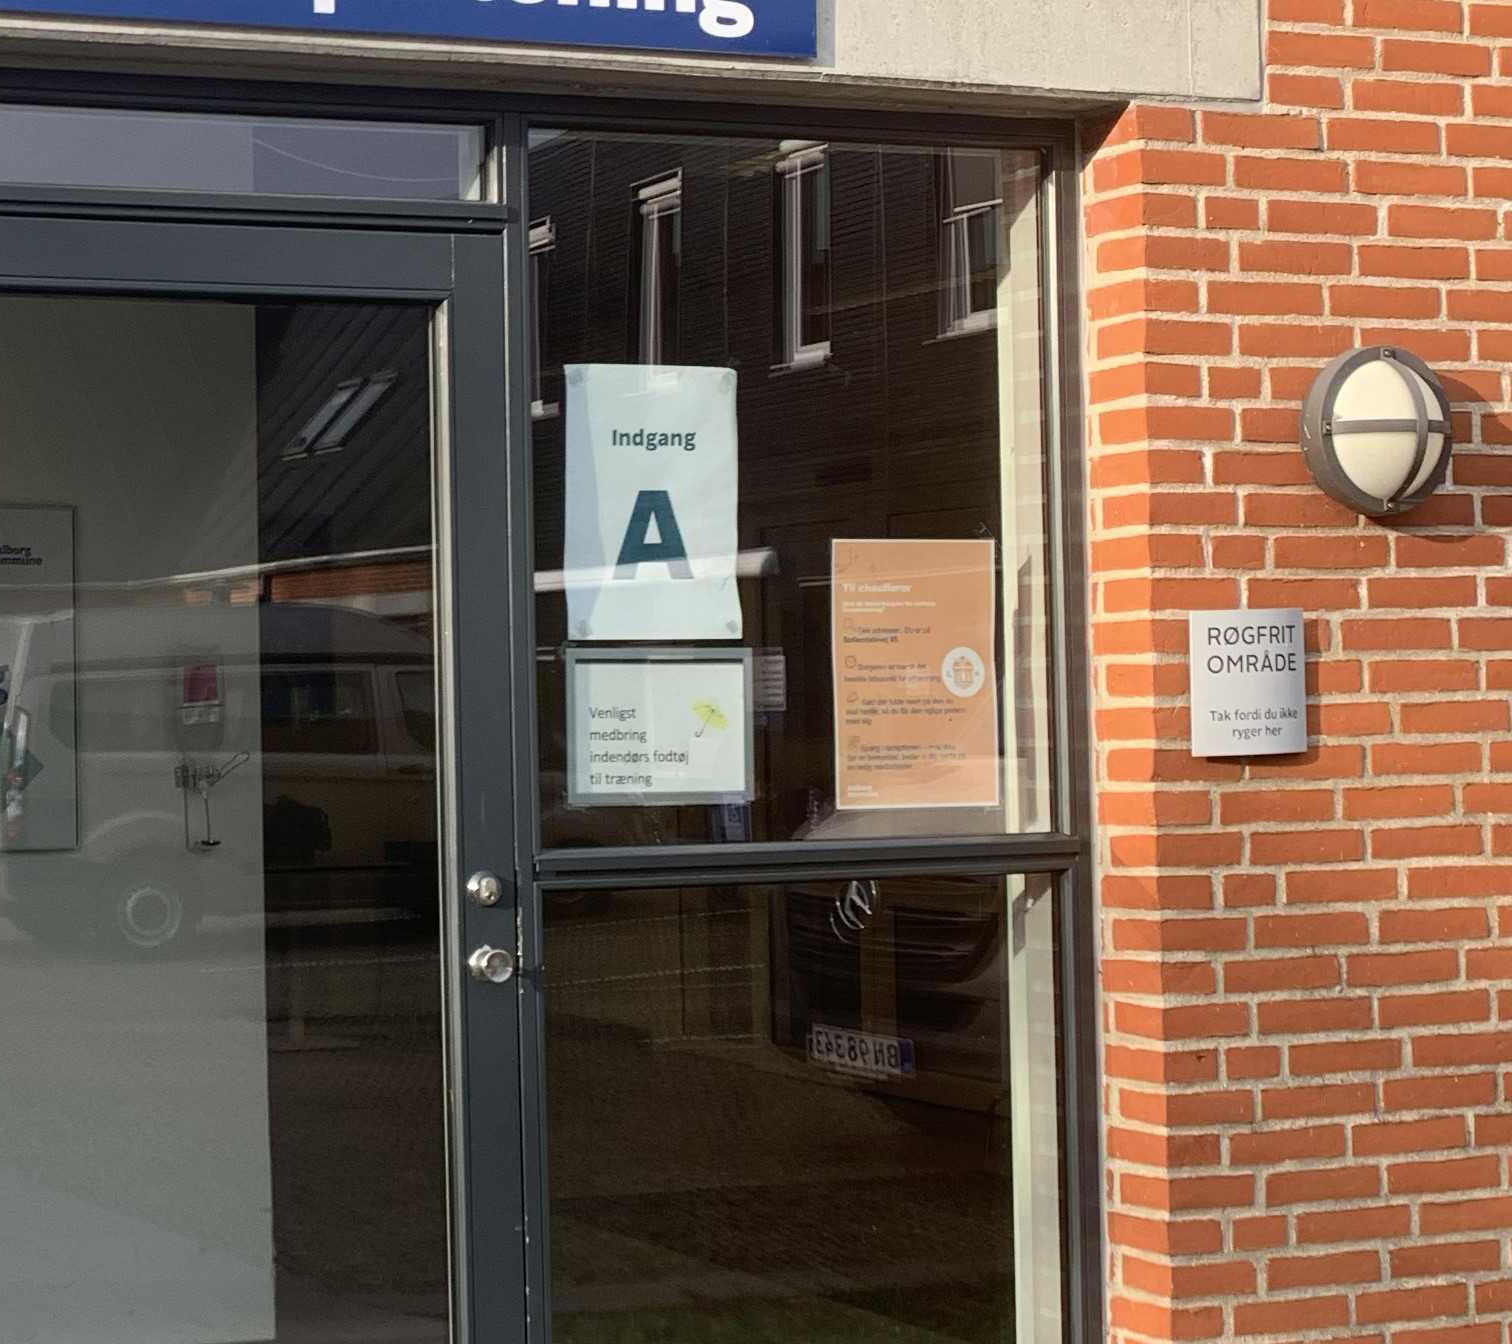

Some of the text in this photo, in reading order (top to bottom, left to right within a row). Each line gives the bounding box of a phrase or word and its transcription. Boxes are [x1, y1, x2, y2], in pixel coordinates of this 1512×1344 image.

[612, 429, 697, 451] Indgang
[612, 490, 694, 580] A
[1208, 625, 1296, 646] RØGFRIT
[1207, 650, 1297, 674] OMRÅDE
[589, 706, 636, 722] Venligst
[1210, 706, 1299, 722] Tak fordi du ikke
[589, 729, 647, 744] medbring
[1232, 725, 1283, 740] ryger her
[590, 750, 689, 765] indendørs fodtøj
[590, 773, 653, 787] til træning
